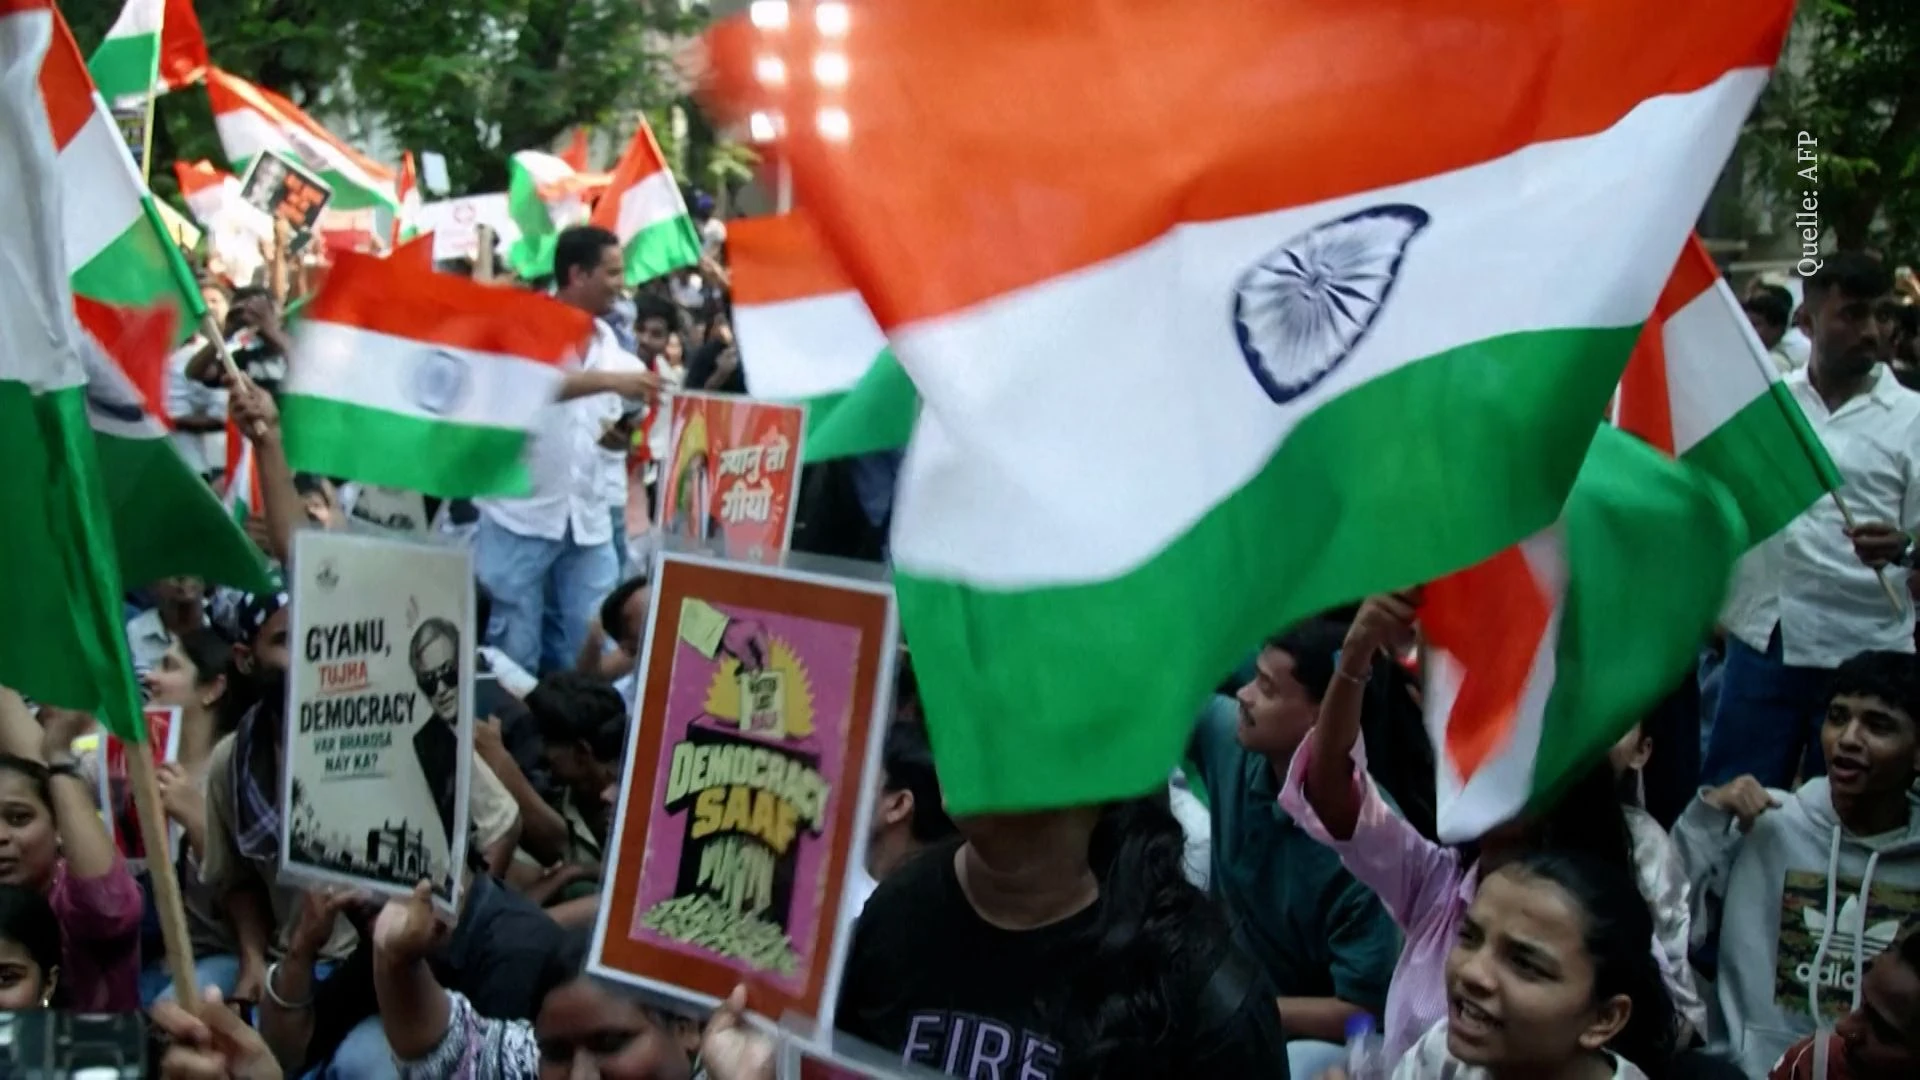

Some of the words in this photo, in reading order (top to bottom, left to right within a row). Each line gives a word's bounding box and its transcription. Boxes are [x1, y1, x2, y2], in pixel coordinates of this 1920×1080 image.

[305, 618, 392, 663] GYANU,
[318, 660, 368, 686] TUJHA
[300, 692, 416, 733] DEMOCRACY
[314, 735, 337, 754] VAR
[339, 731, 392, 750] BHAROSA
[325, 755, 351, 773] NAY
[665, 741, 832, 832] DEMOCRACY
[691, 785, 800, 854] SAAF
[1795, 961, 1858, 991] adid
